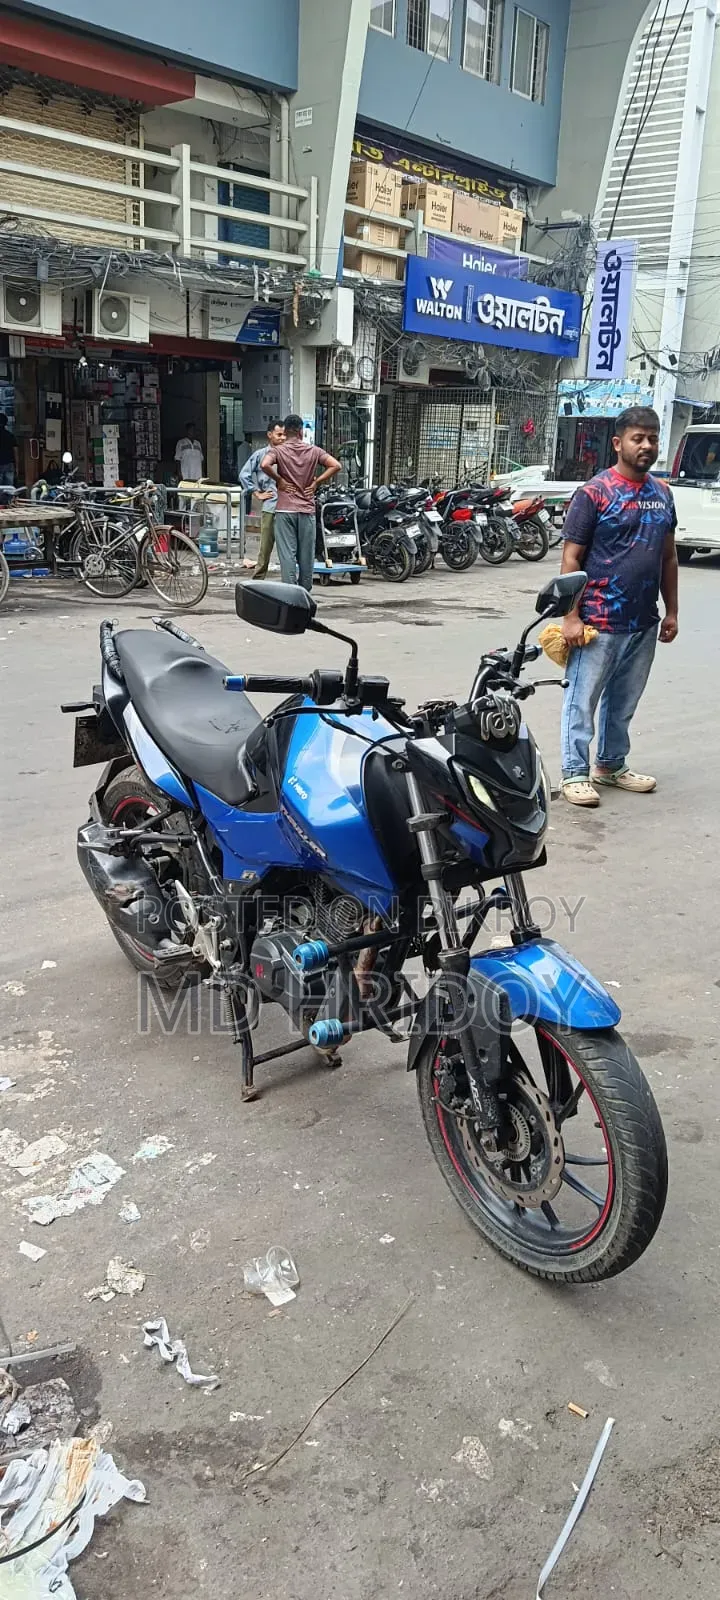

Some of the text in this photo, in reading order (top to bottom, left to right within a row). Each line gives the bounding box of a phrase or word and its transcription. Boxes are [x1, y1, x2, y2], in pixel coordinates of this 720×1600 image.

[431, 201, 448, 213] Haier
[457, 222, 473, 234] Haier
[503, 220, 518, 233] Haier
[479, 229, 494, 241] Haier
[462, 253, 498, 275] Haier
[416, 298, 463, 321] WALTON
[477, 293, 566, 337] ওয়ালটন
[596, 249, 622, 372] ওয়ালটন
[219, 381, 240, 390] ALTON
[621, 500, 666, 510] HIKVISION
